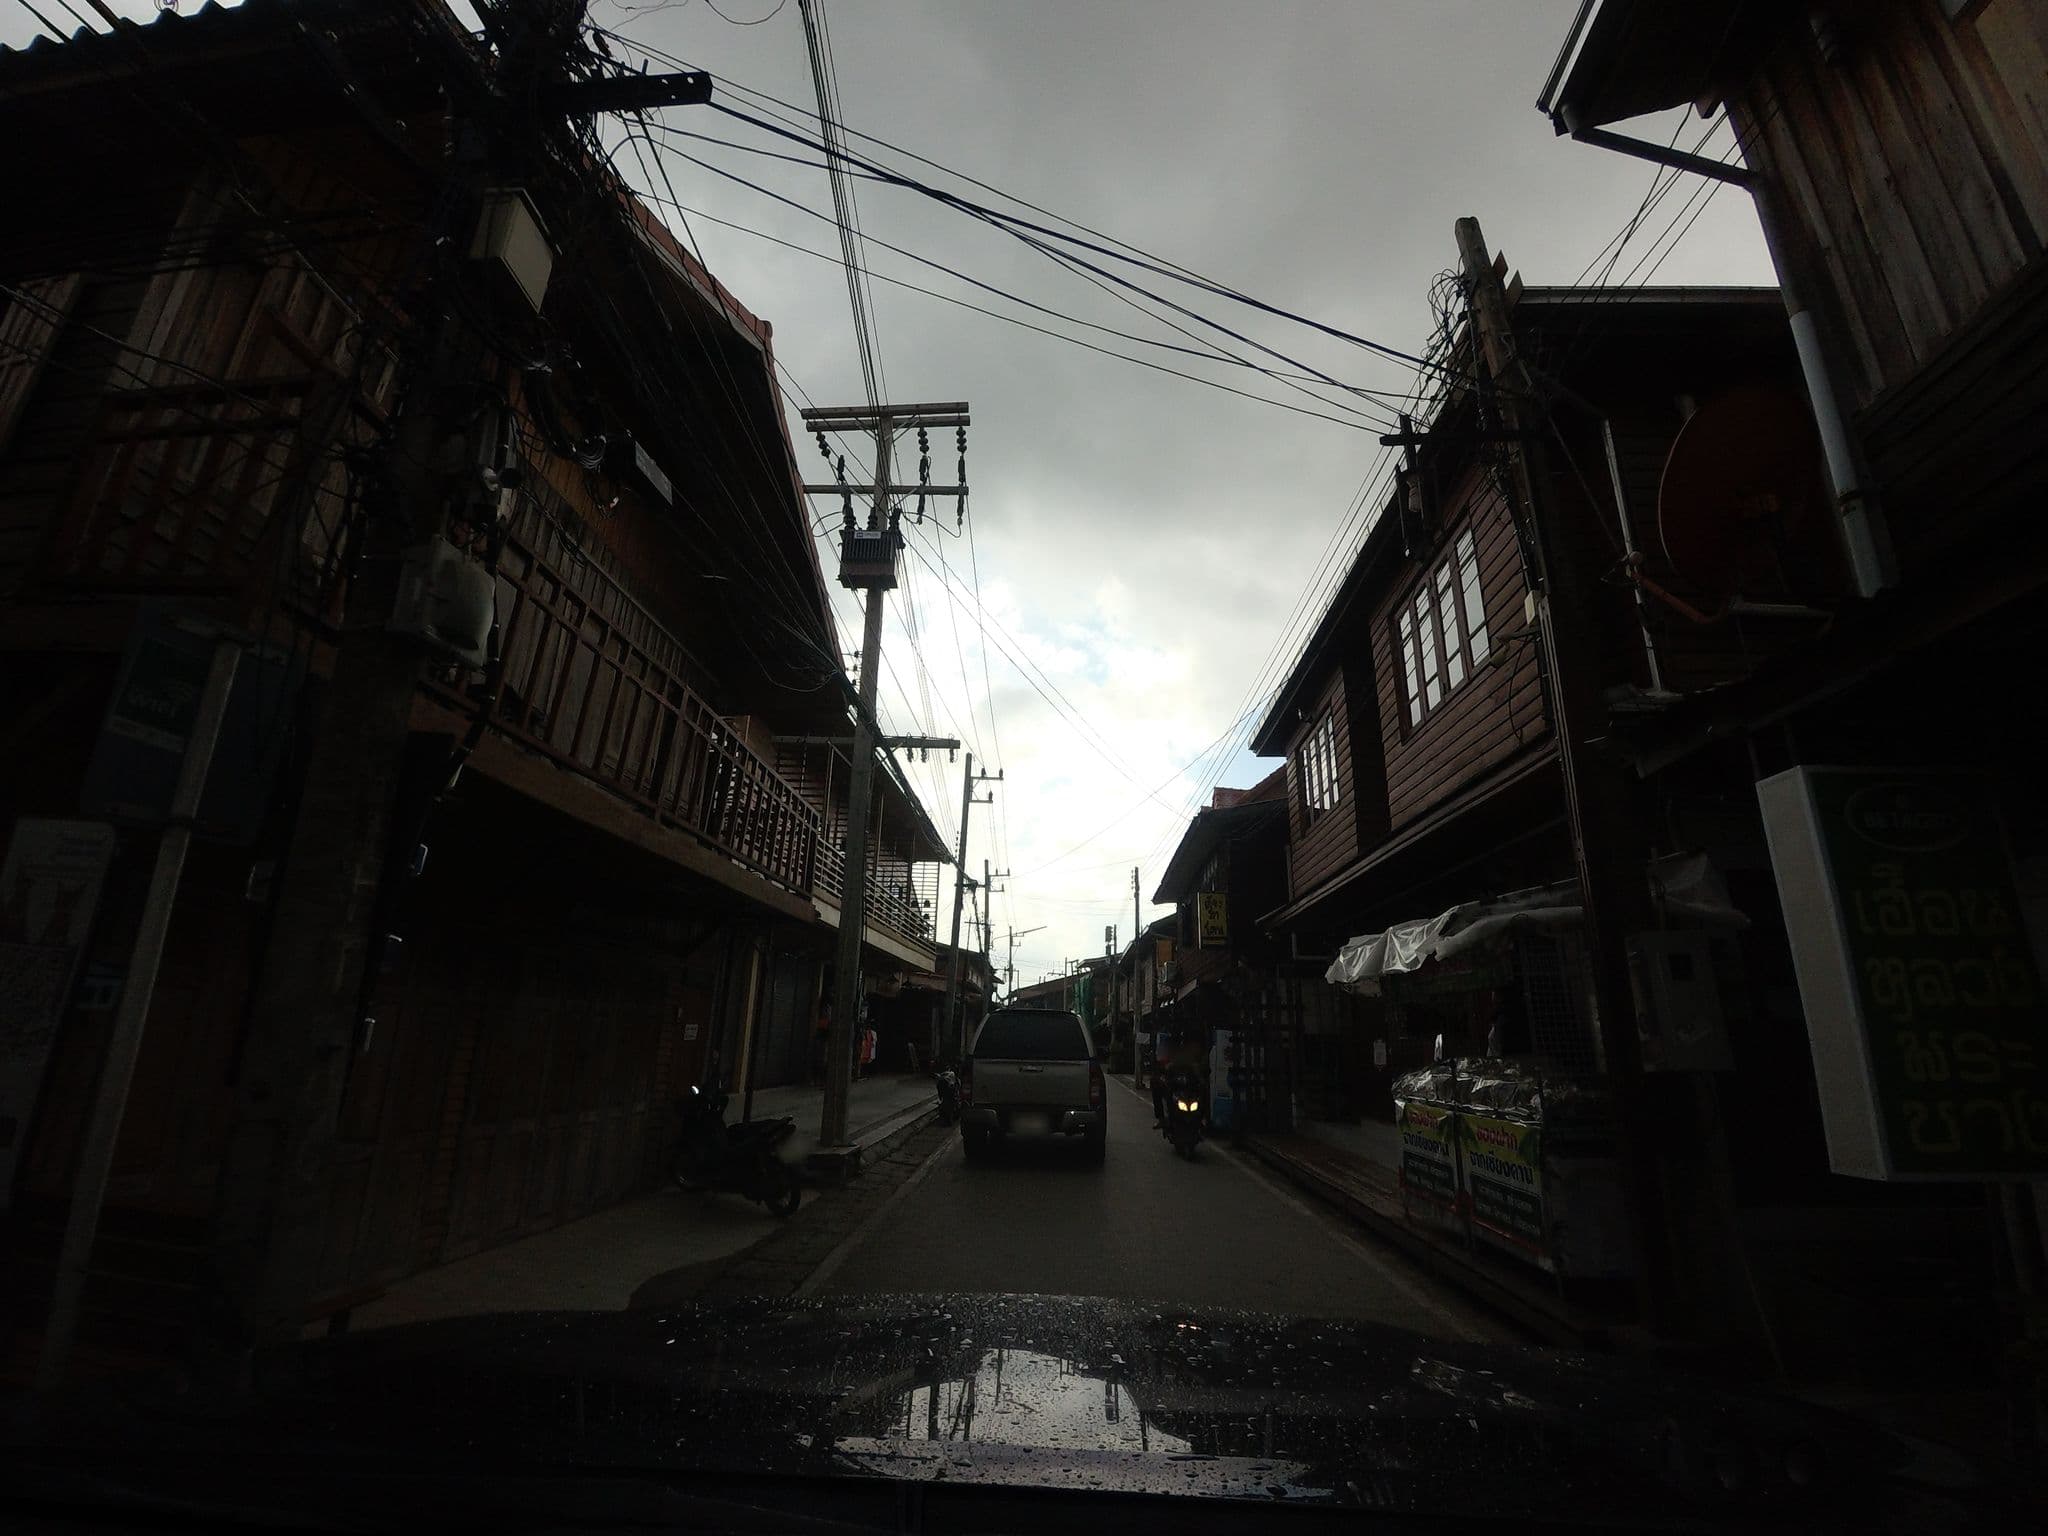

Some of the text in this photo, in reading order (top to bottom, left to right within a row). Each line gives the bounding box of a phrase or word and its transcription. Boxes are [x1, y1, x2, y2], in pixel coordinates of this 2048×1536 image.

[1469, 1150, 1534, 1185] จากเชียงคาน
